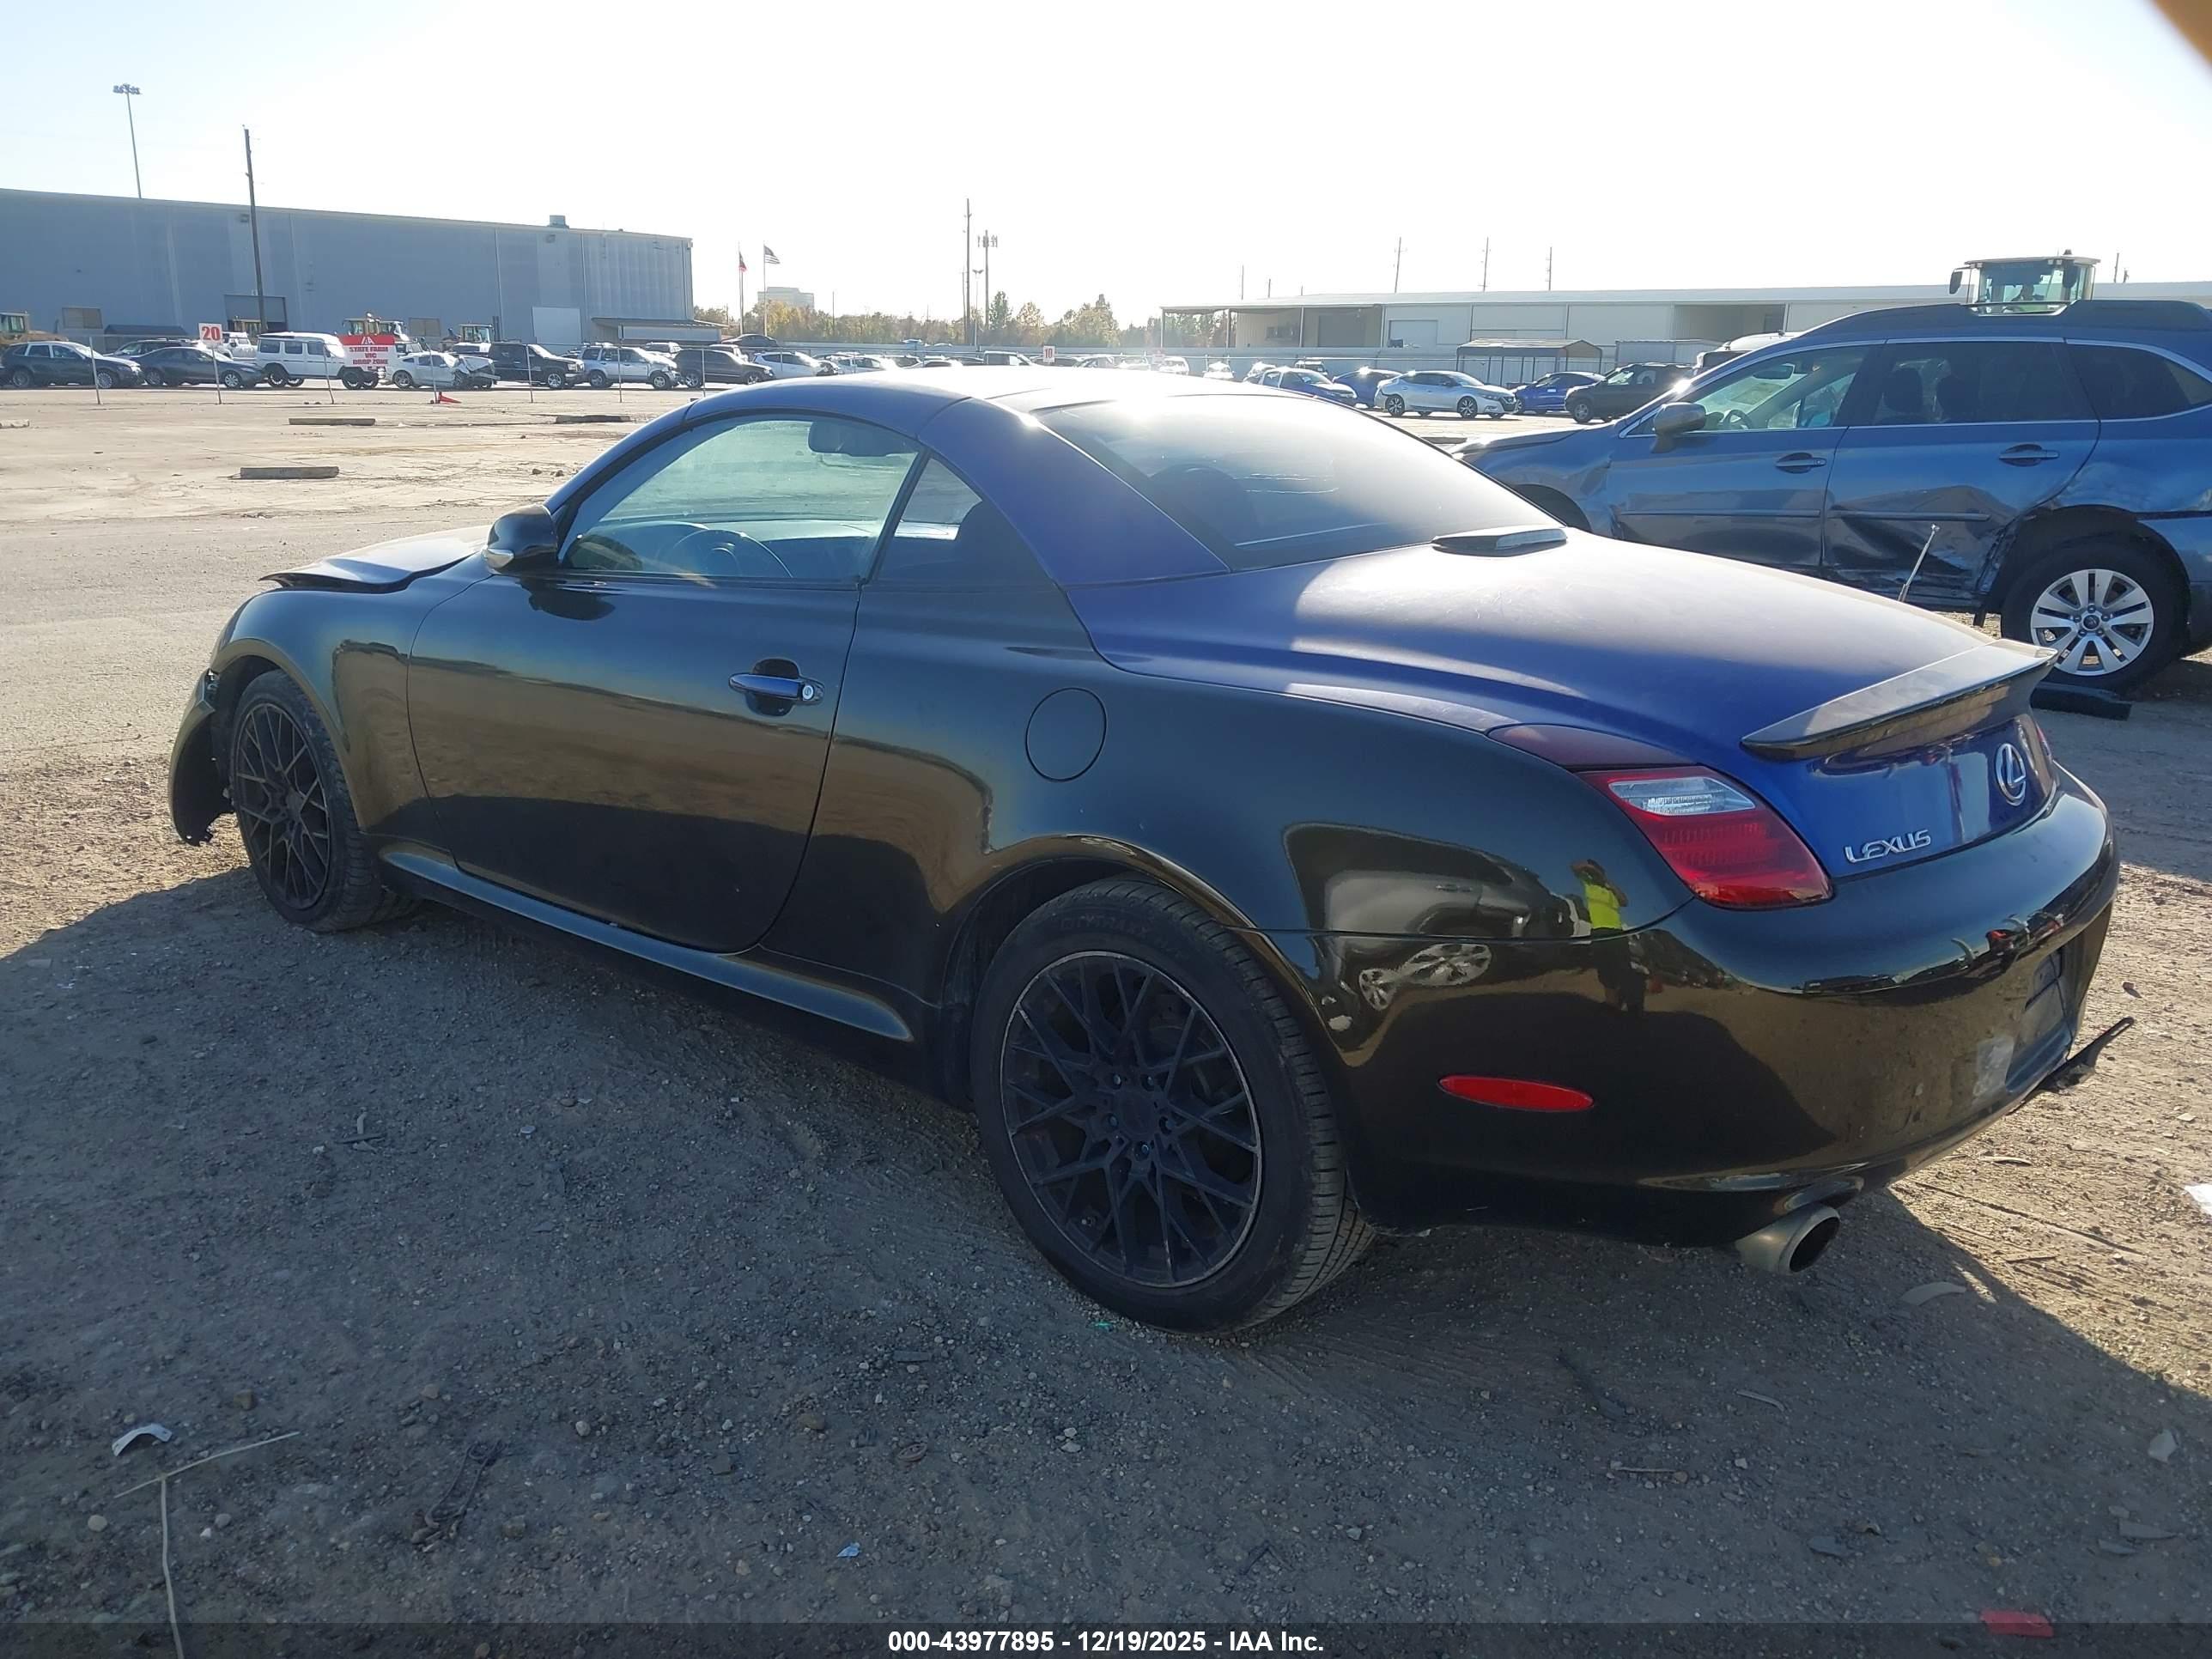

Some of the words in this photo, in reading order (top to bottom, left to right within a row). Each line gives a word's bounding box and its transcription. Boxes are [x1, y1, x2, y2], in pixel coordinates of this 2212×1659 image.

[202, 326, 221, 341] 20
[1044, 348, 1053, 358] 10
[1844, 830, 1931, 863] LEXUS
